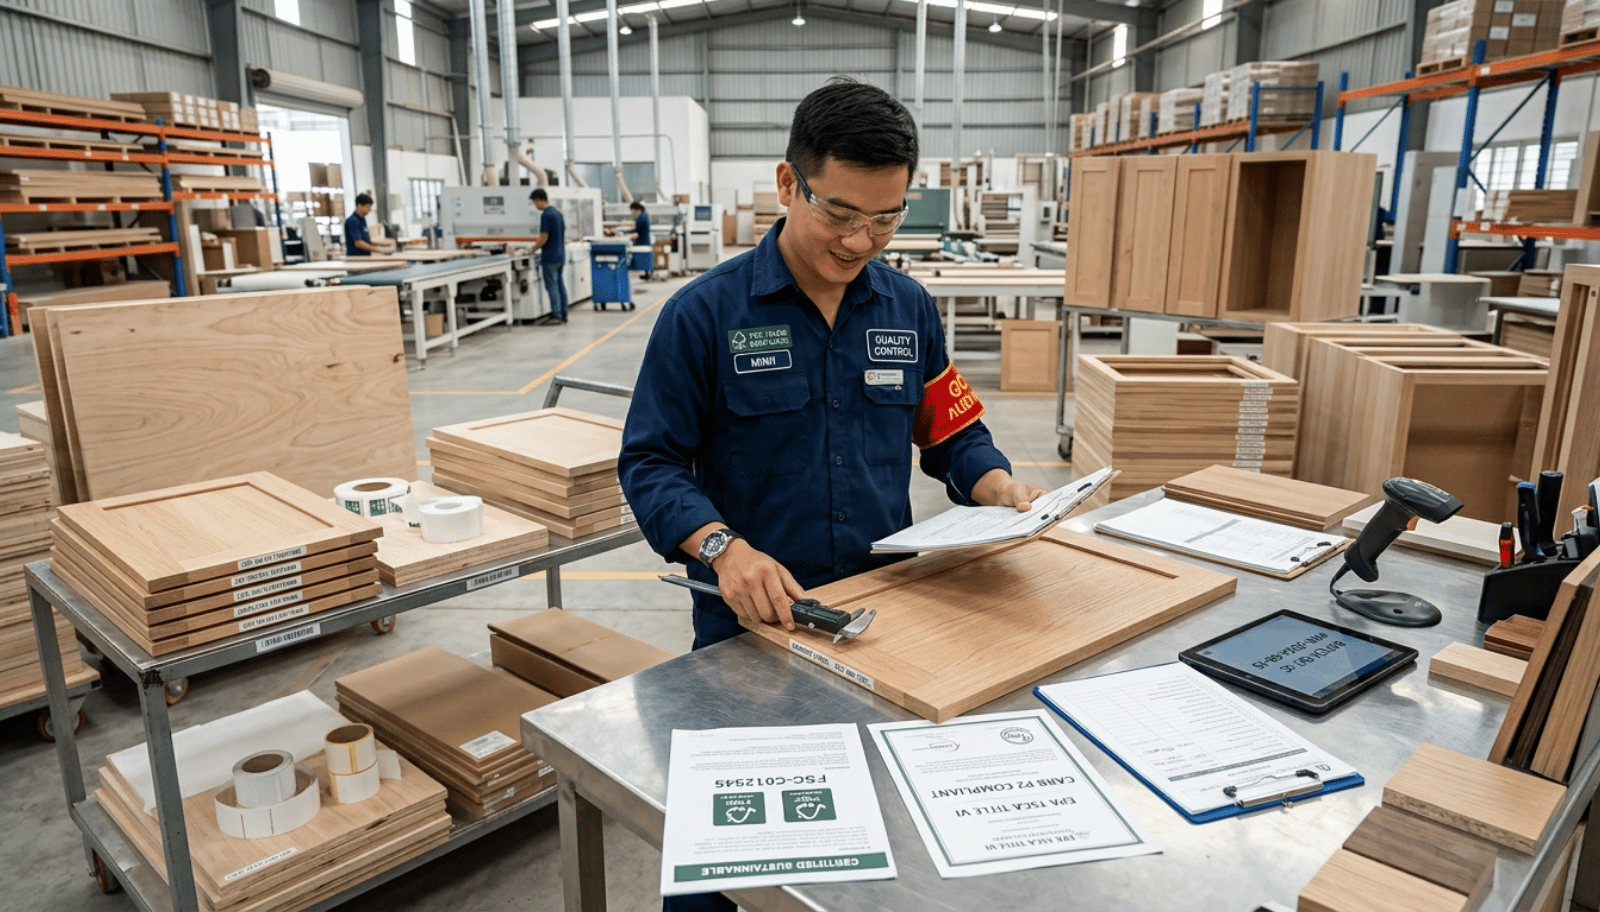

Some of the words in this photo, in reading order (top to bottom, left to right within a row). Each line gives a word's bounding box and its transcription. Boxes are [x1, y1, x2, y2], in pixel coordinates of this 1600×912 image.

[875, 335, 911, 346] QUALITY
[874, 346, 914, 357] CONTROL
[1017, 780, 1035, 789] P2
[931, 782, 1014, 799] COMPLIANT
[1012, 800, 1047, 811] TSCA
[1049, 796, 1077, 806] EPA
[955, 808, 972, 817] VI
